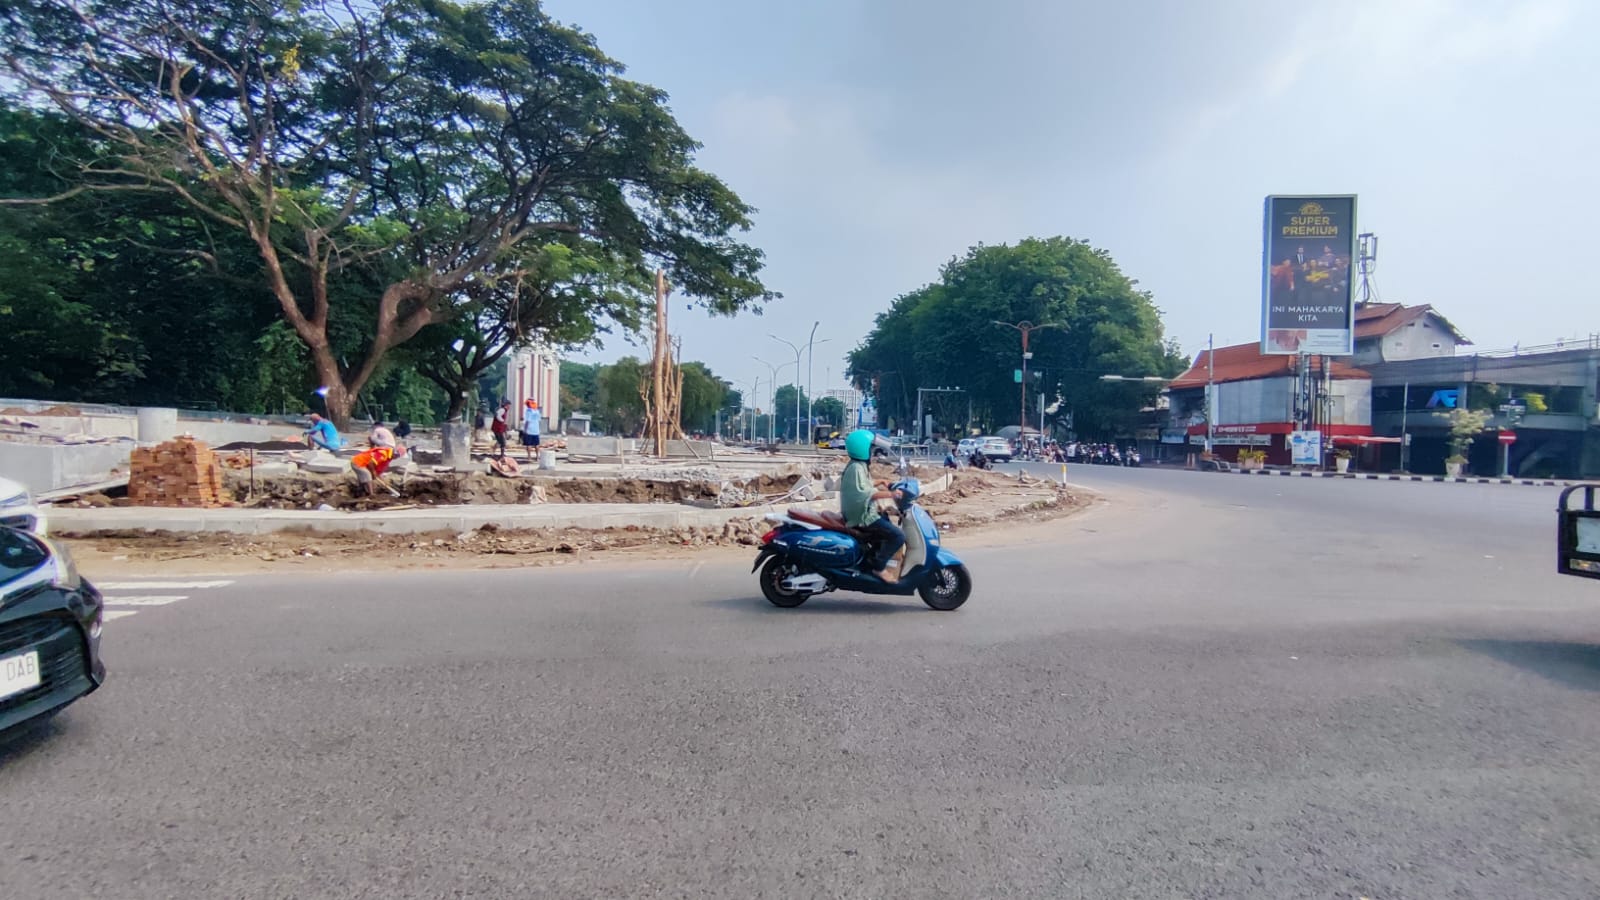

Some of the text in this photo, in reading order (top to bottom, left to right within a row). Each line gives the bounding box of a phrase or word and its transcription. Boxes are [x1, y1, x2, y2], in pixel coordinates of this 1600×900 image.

[1291, 216, 1330, 225] SUPER
[1282, 226, 1338, 235] PREMIUM
[1288, 305, 1344, 313] MAHAKARYA
[1298, 314, 1318, 322] KITA
[7, 656, 35, 681] DAB
